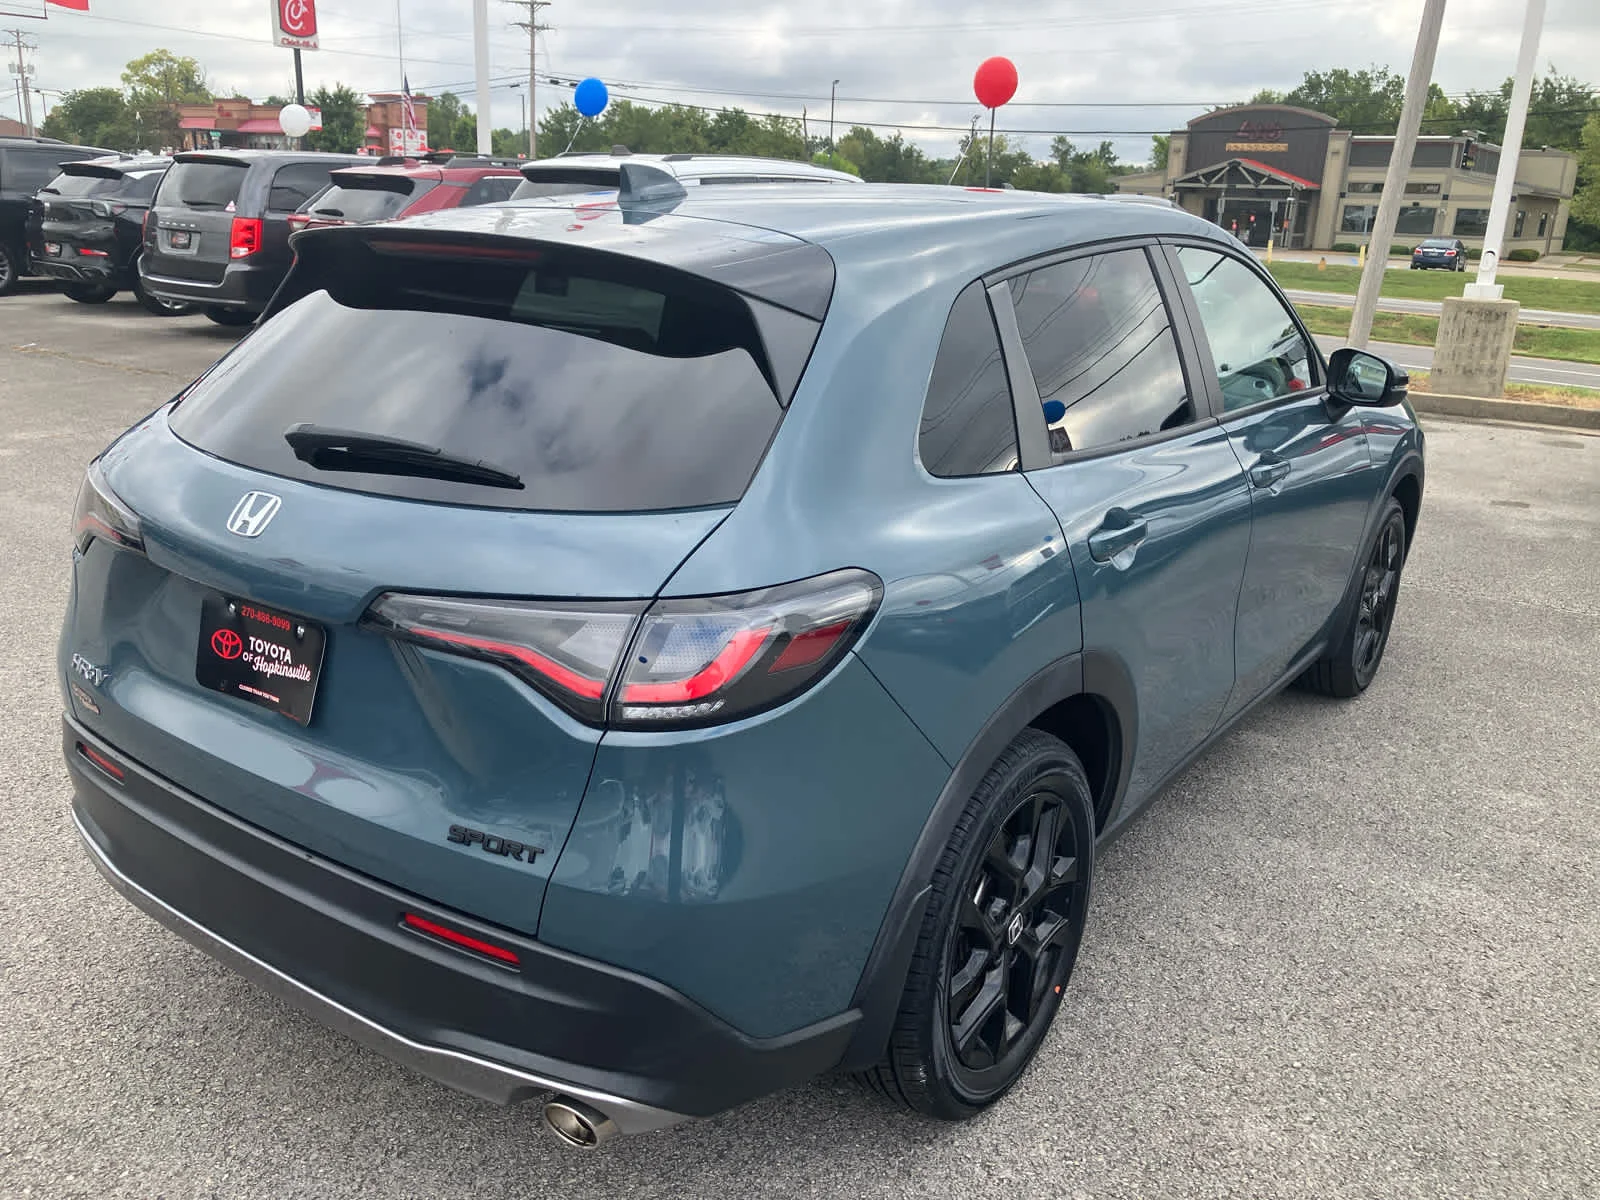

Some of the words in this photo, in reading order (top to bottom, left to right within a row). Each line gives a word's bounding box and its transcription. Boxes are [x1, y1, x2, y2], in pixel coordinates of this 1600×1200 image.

[249, 636, 292, 664] TOYOTA
[243, 652, 253, 662] OF
[252, 656, 311, 682] Hopkinsville
[447, 824, 545, 864] SPORT
